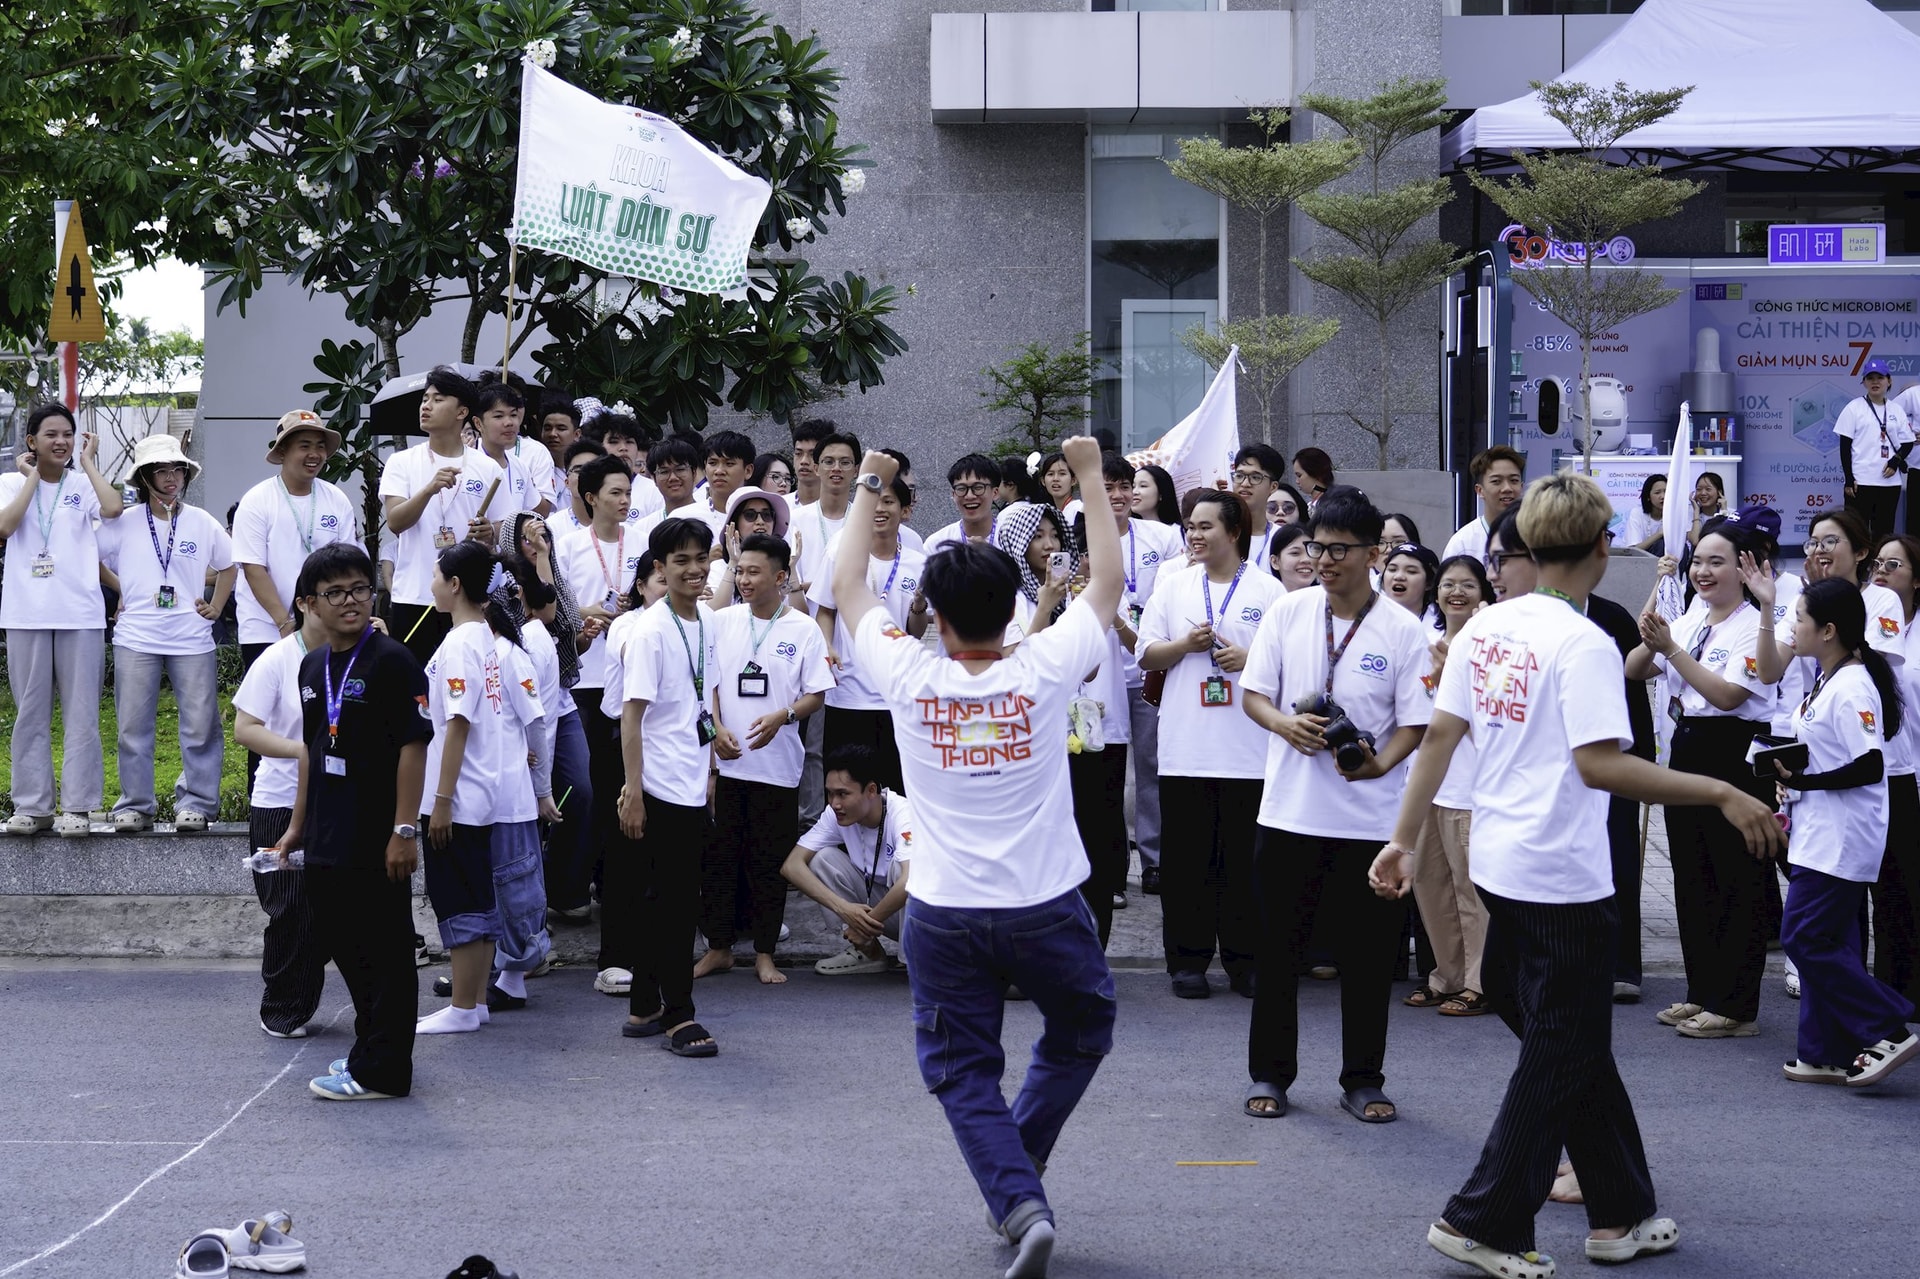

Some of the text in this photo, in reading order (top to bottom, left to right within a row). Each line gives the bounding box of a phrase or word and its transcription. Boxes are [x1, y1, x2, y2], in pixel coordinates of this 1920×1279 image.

[609, 144, 671, 193] KHOA
[560, 181, 717, 262] LUẬT DÂN SỰ
[1509, 236, 1547, 263] 30
[1755, 300, 1911, 312] CÔNG THỨC MICROBIOME
[1737, 317, 1772, 338] CẢI
[1779, 317, 1839, 342] THIỆN
[1847, 321, 1876, 338] DA
[1525, 335, 1572, 352] -85%
[1738, 342, 1914, 376] GIẢM MỤN SAU 7 GÀY
[1738, 395, 1770, 410] 10X
[1807, 494, 1833, 507] 85%
